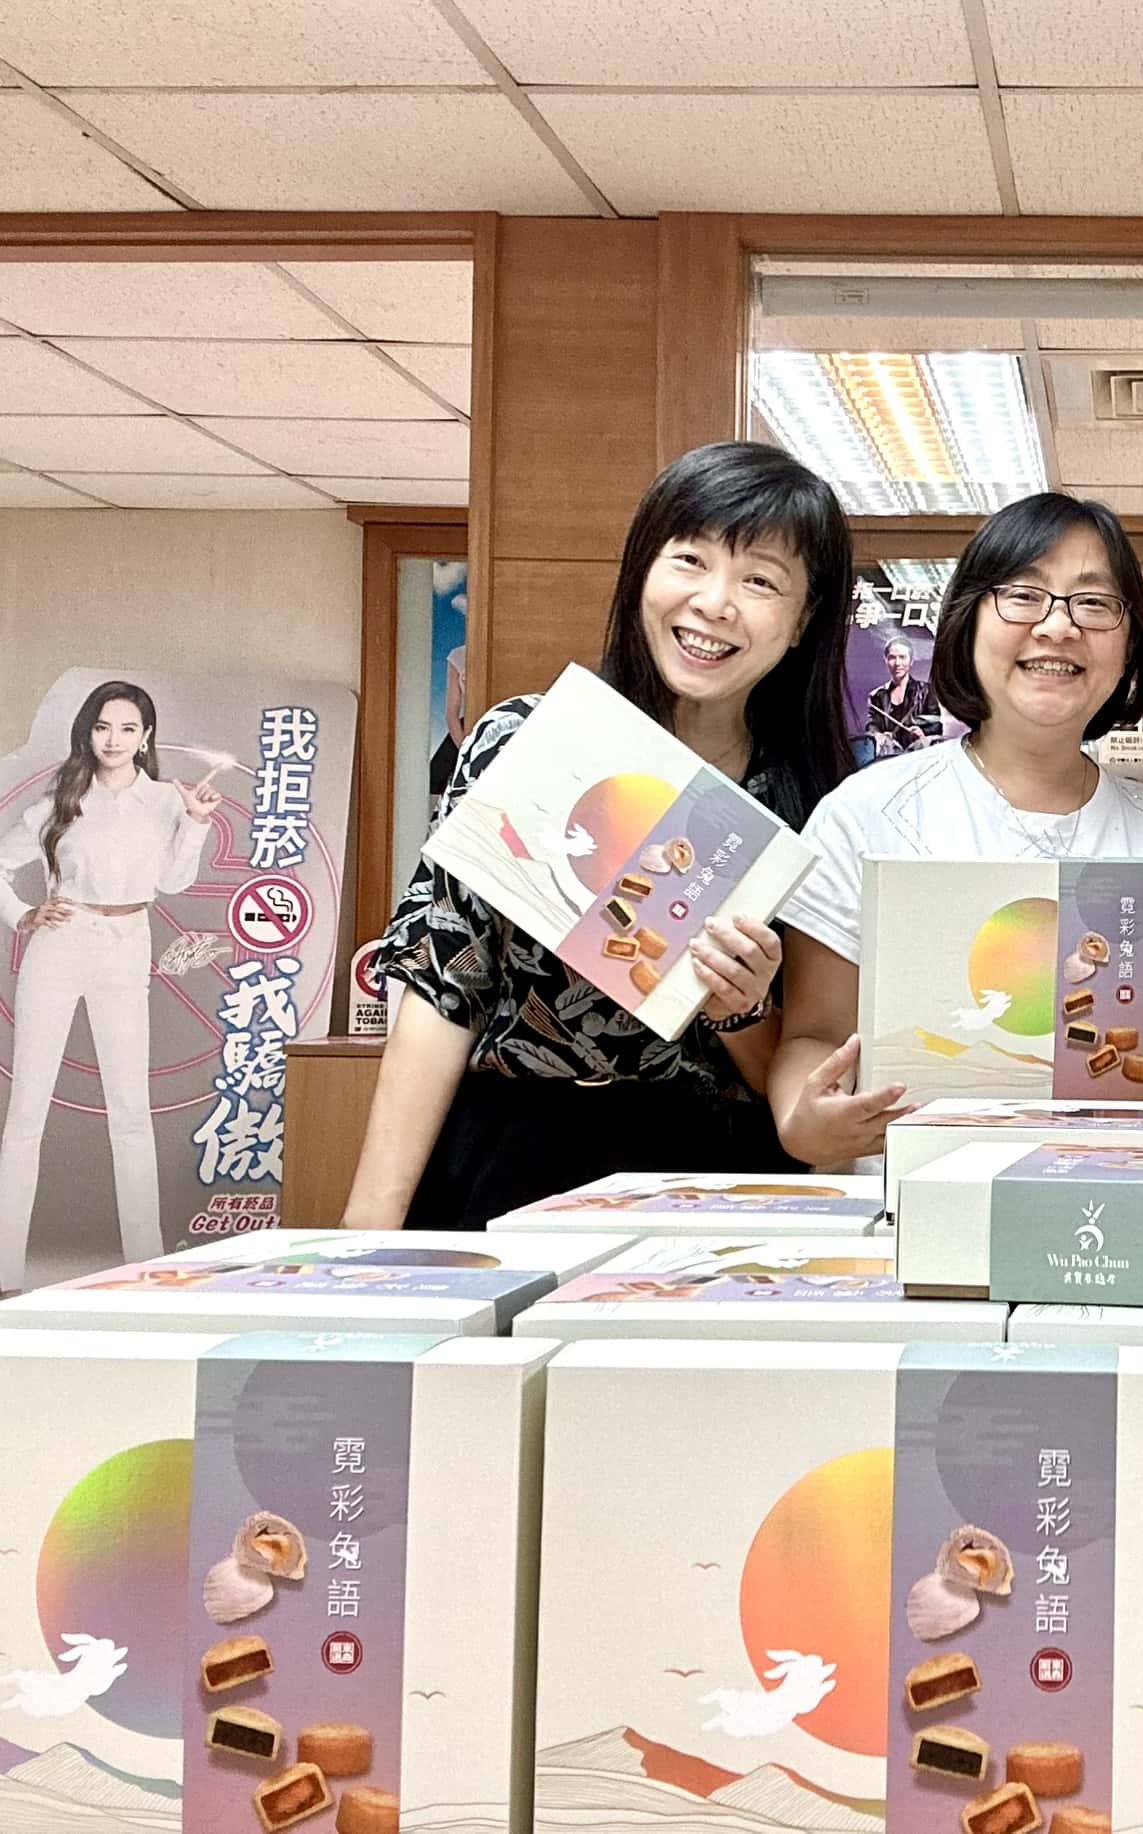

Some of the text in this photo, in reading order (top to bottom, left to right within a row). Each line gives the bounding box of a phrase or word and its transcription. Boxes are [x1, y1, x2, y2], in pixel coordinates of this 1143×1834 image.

[250, 708, 317, 869] 我拒菸
[683, 831, 743, 901] 霓彩兔語
[1118, 896, 1136, 979] 霓彩兔語
[356, 1009, 387, 1017] AGAI
[190, 1214, 230, 1232] Get
[210, 1196, 275, 1211] 所有菸品
[1047, 1253, 1130, 1269] Wu Pao Chun
[327, 1437, 366, 1617] 霓彩兔語
[1035, 1448, 1072, 1634] 霓彩兔語
